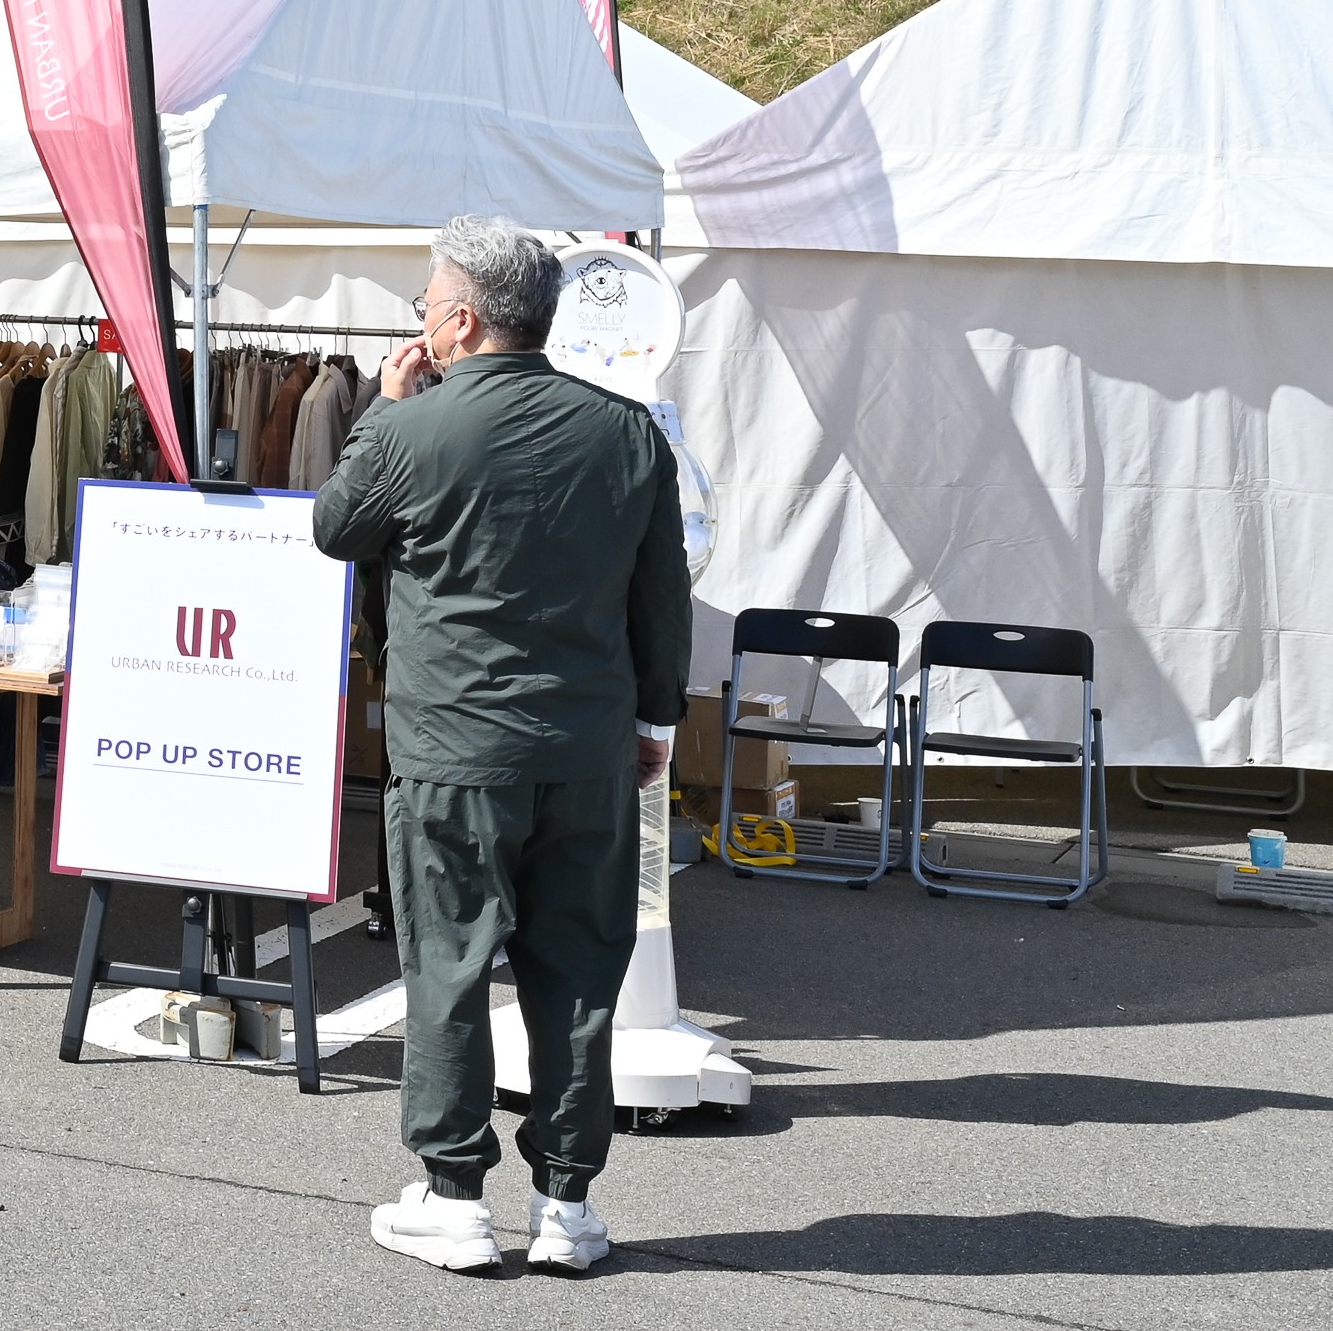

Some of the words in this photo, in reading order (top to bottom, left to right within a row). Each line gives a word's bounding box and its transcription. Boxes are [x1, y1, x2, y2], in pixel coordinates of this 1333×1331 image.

[578, 311, 626, 325] SMELLY
[175, 605, 237, 661] UR
[111, 656, 162, 671] URBAN
[166, 660, 241, 678] RESEARCH
[245, 666, 299, 683] Co.,Ltd.
[96, 737, 152, 761] POP
[162, 743, 198, 766] UP
[207, 747, 303, 777] STORE
